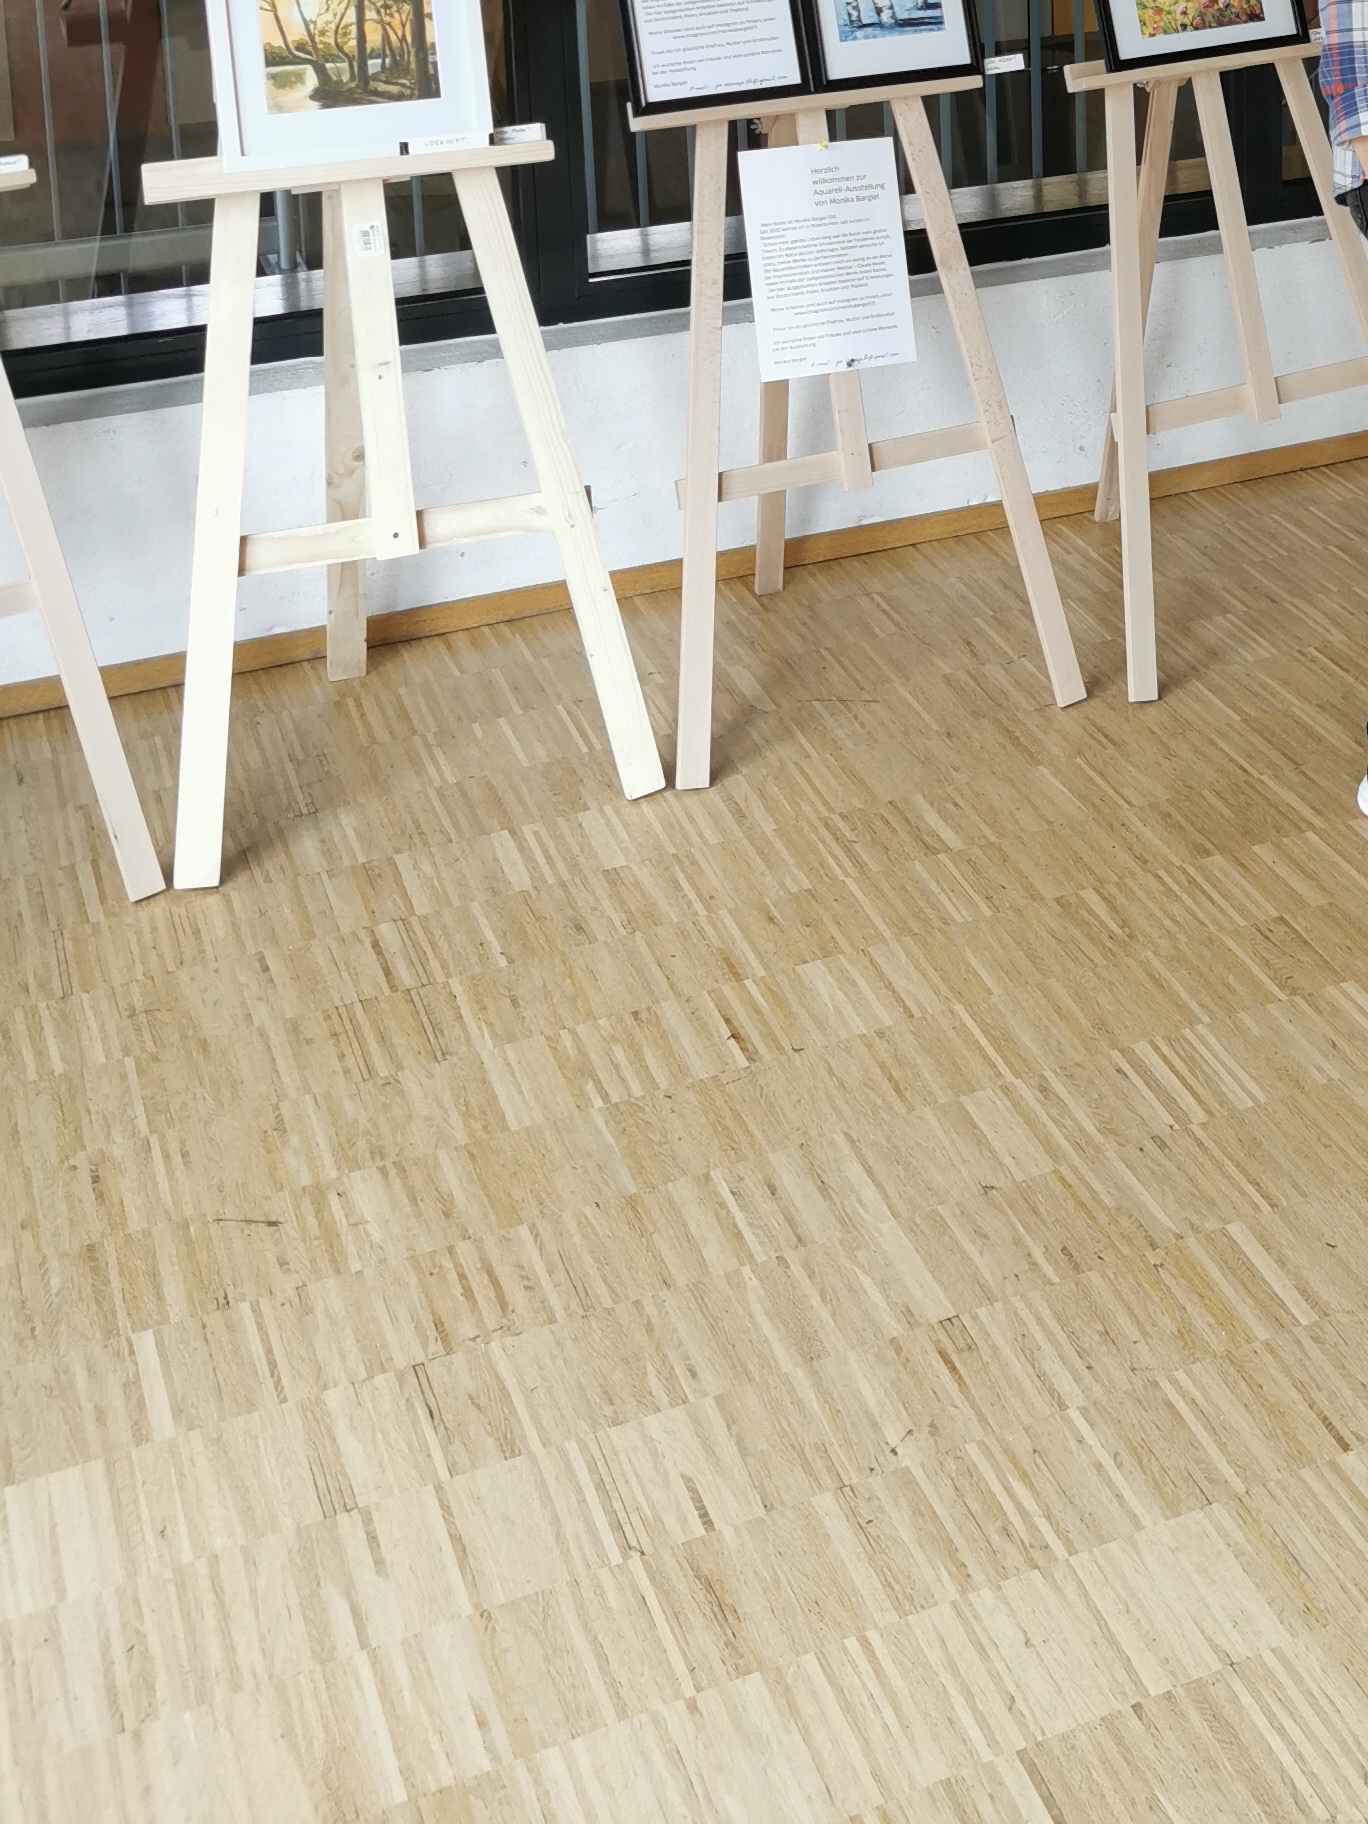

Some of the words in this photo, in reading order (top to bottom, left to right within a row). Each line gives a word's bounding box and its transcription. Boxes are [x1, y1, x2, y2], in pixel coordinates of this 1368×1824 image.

[810, 165, 840, 175] Herzlich
[811, 174, 854, 185] willkommen
[855, 173, 867, 181] zur
[812, 182, 886, 197] Aquarell-Ausstellung
[829, 195, 854, 205] Monika
